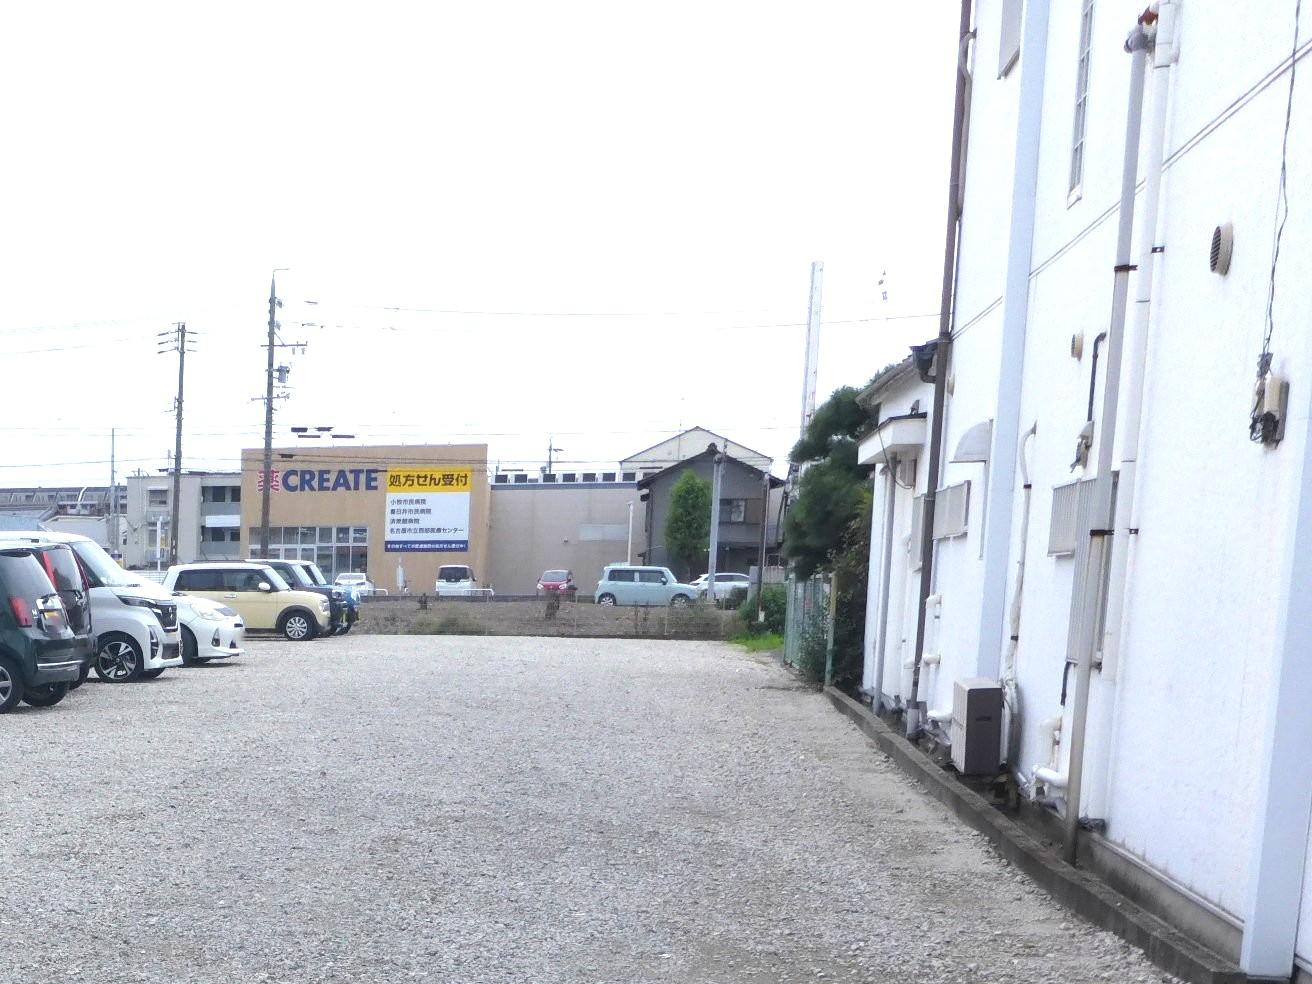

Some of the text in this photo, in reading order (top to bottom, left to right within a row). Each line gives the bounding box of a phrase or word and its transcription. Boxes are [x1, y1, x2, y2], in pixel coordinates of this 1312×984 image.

[282, 469, 379, 492] CREATE
[389, 473, 469, 487] 処方せん受付
